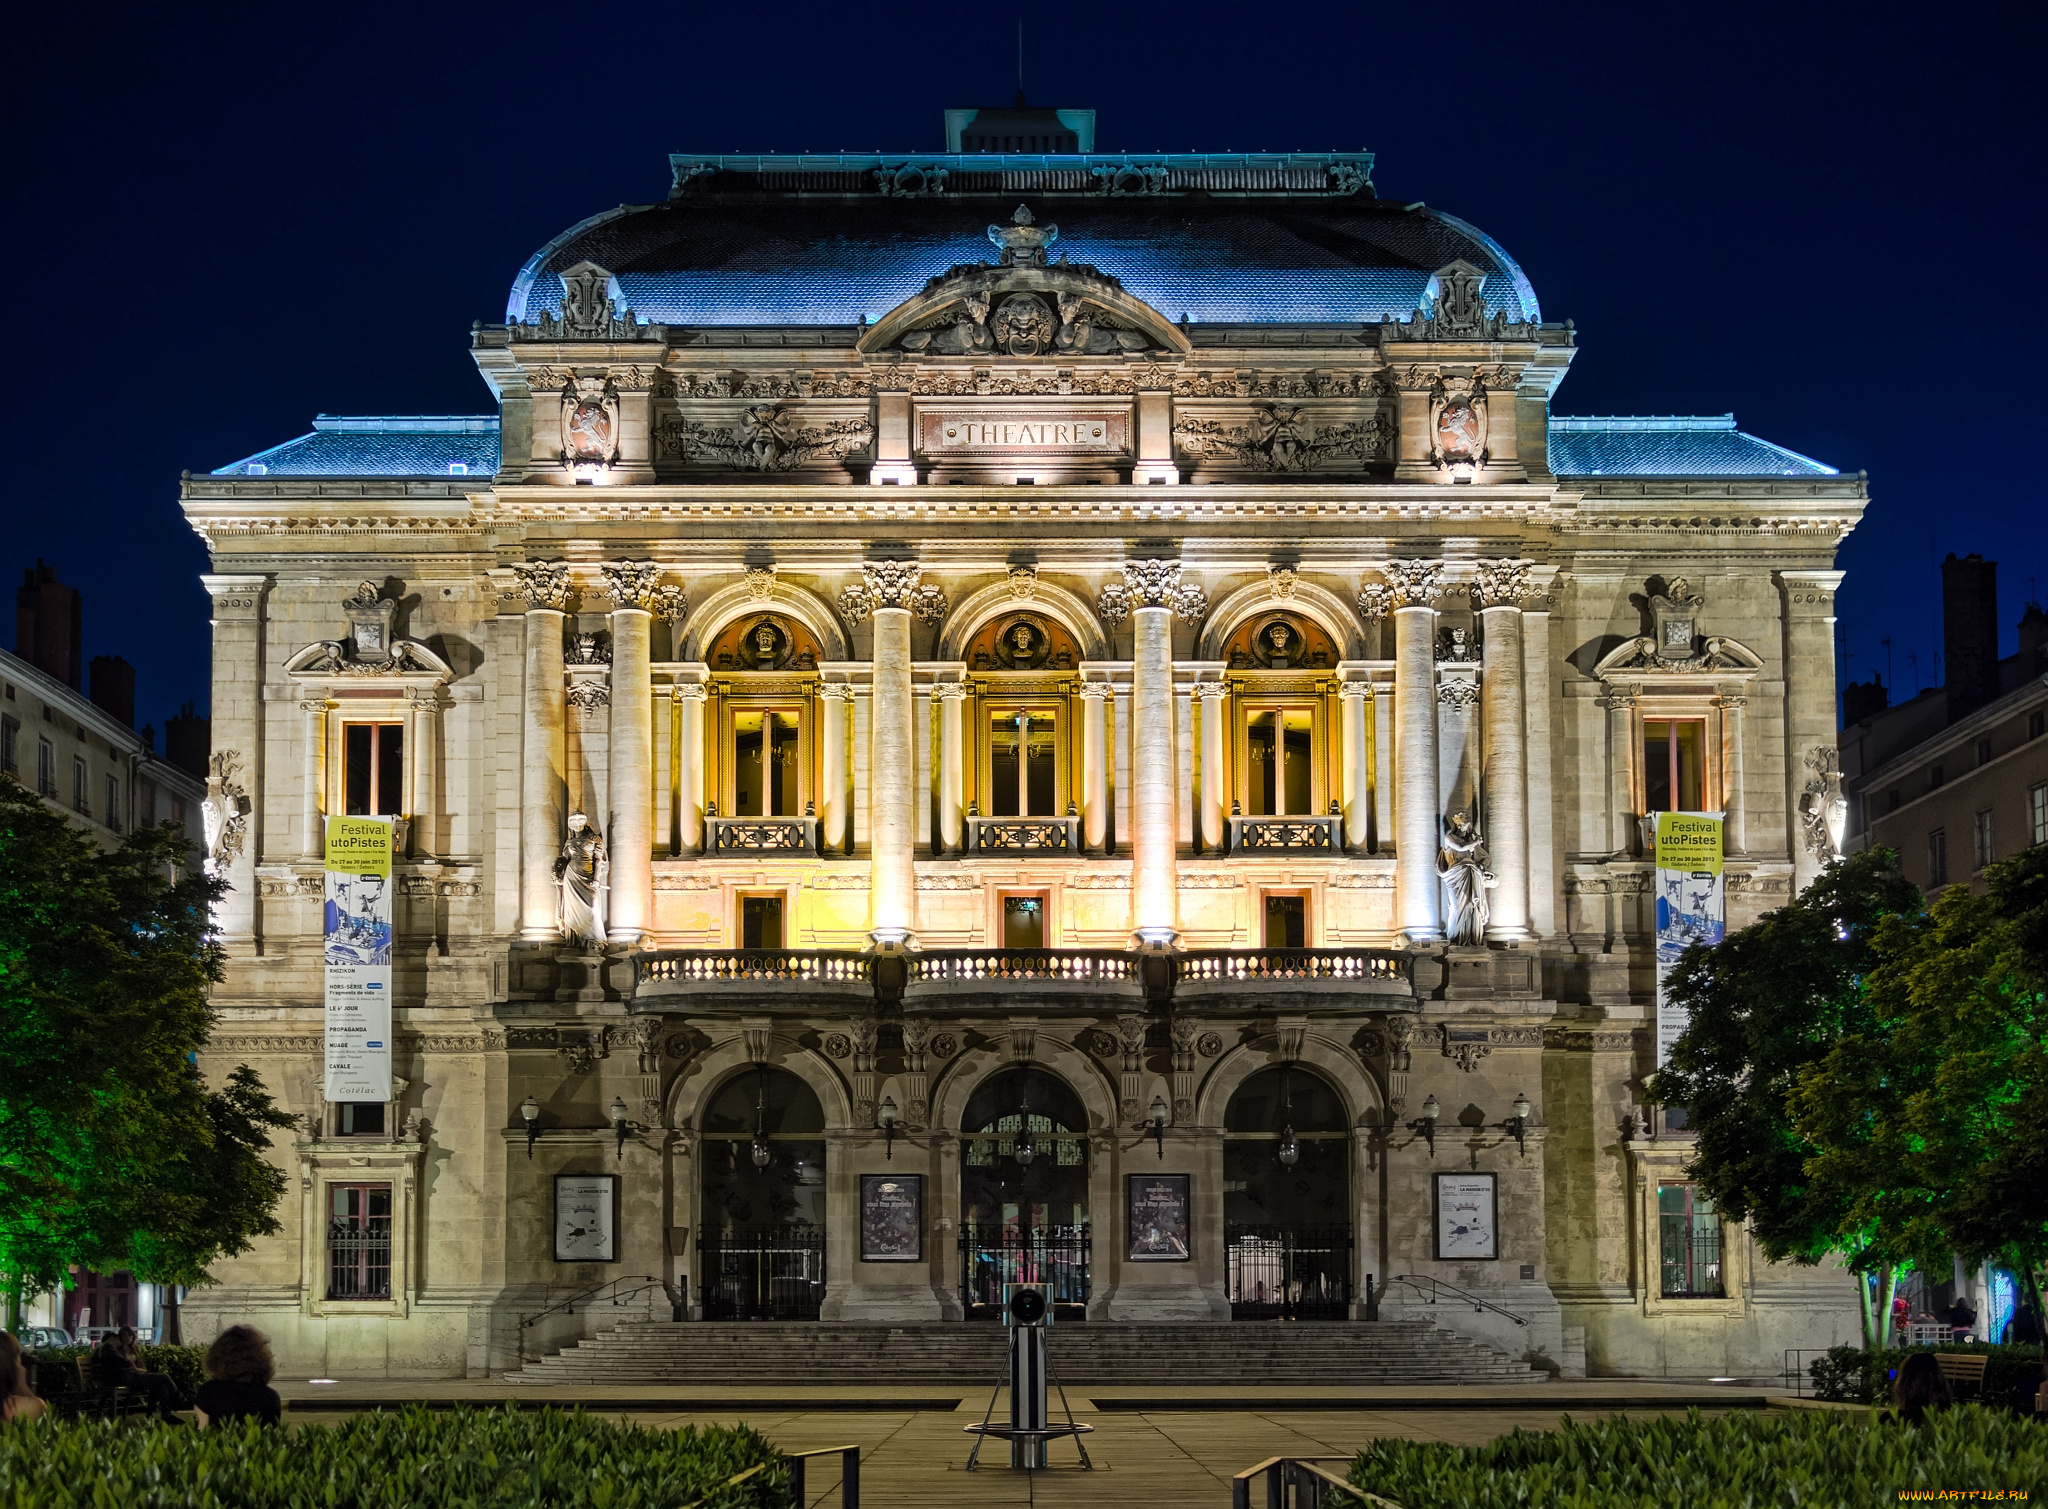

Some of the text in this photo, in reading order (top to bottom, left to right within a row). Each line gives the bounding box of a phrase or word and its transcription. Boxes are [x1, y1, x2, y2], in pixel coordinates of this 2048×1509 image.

[961, 423, 1088, 444] THEATRE
[341, 824, 386, 834] Festival
[1672, 822, 1716, 832] Festival
[331, 838, 386, 848] utoPistes
[1662, 834, 1716, 845] utoPistes
